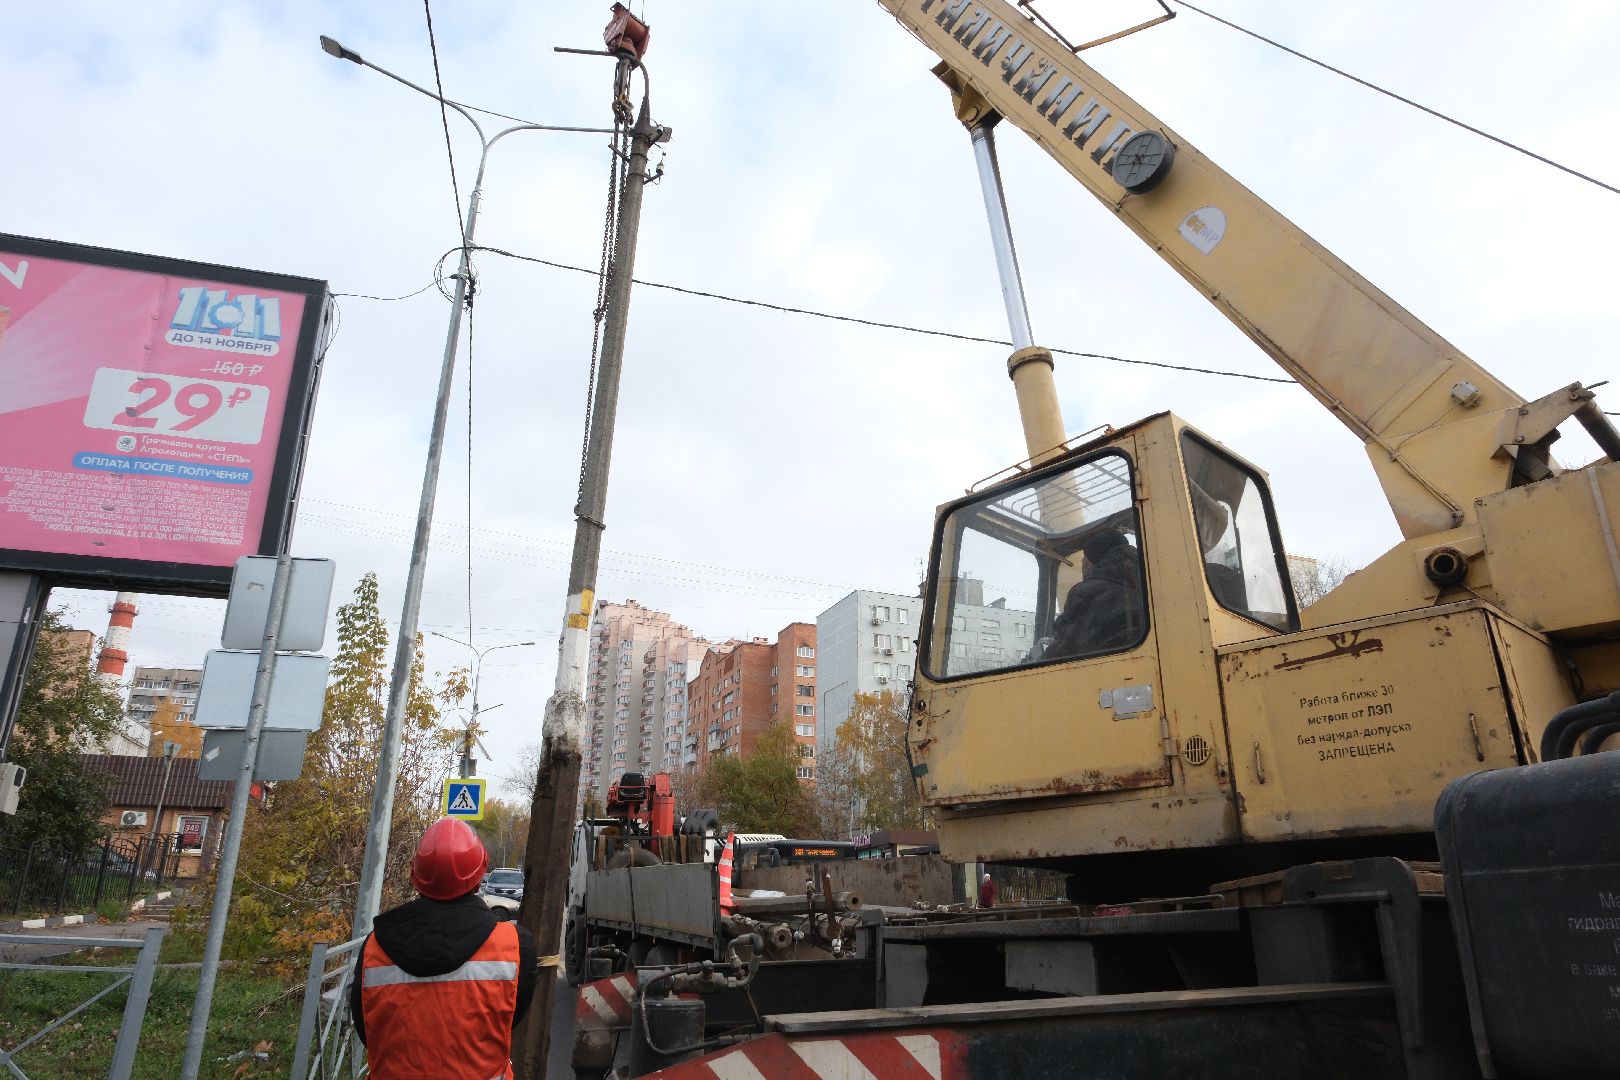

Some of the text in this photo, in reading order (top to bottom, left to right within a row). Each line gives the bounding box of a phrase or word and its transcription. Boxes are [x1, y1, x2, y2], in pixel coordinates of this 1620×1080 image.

[921, 0, 1138, 176] АЛИЧАНИН
[171, 333, 273, 353] ДО 14 НОЯБРЯ
[140, 445, 205, 459] Агрохолдинг
[141, 436, 226, 452] Гречневая крупа
[81, 456, 249, 480] ОПЛАТА ПОСЛЕ ПОЛУЧЕНИЯ
[1299, 685, 1394, 708] Работа ближе 30
[1308, 703, 1393, 725] метров от ЛЭП
[1298, 723, 1412, 745] без наряда-допуска
[1318, 742, 1395, 761] ЗАПРЕЩЕНА
